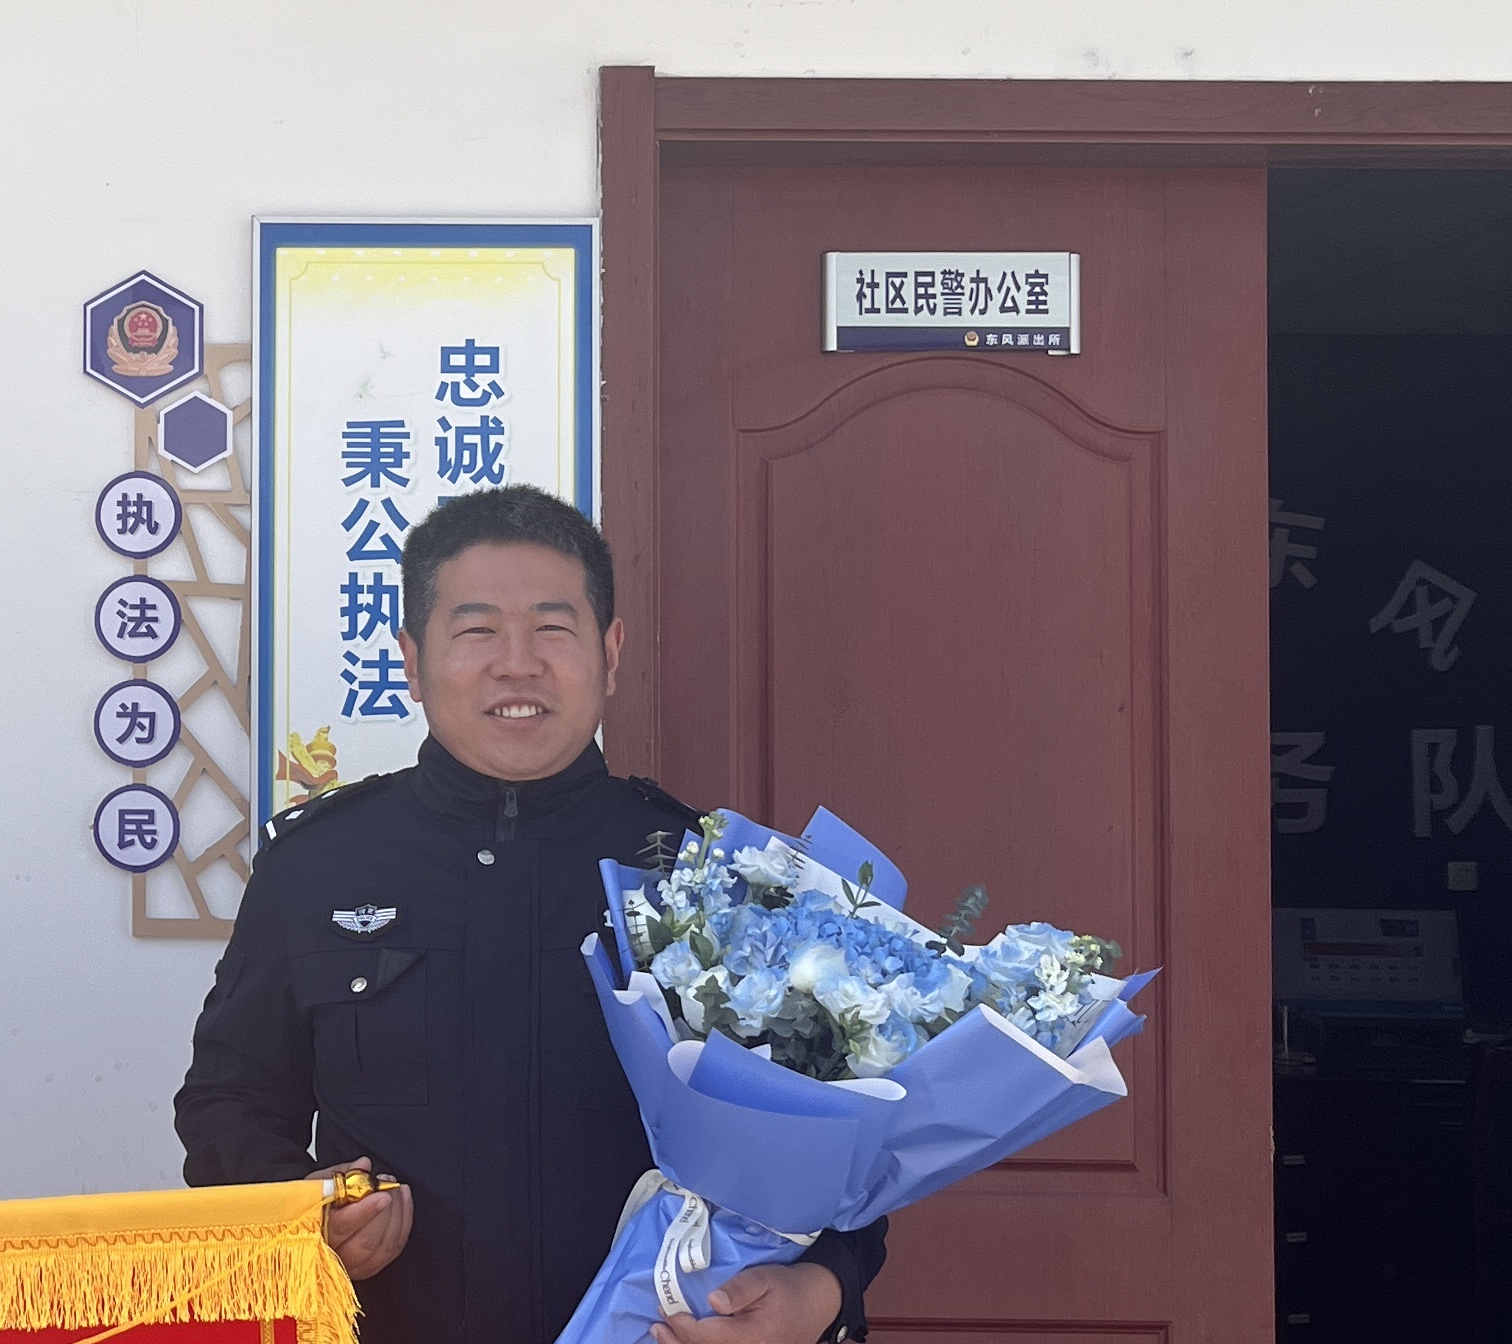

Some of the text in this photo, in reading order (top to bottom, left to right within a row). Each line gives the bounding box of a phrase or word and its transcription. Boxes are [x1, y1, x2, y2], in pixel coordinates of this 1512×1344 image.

[855, 268, 1050, 317] 社区民警办公室
[985, 333, 1061, 346] 东风派出所
[434, 338, 507, 507] 忠诚
[340, 419, 412, 720] 秉公执法
[114, 491, 162, 851] 执法为民
